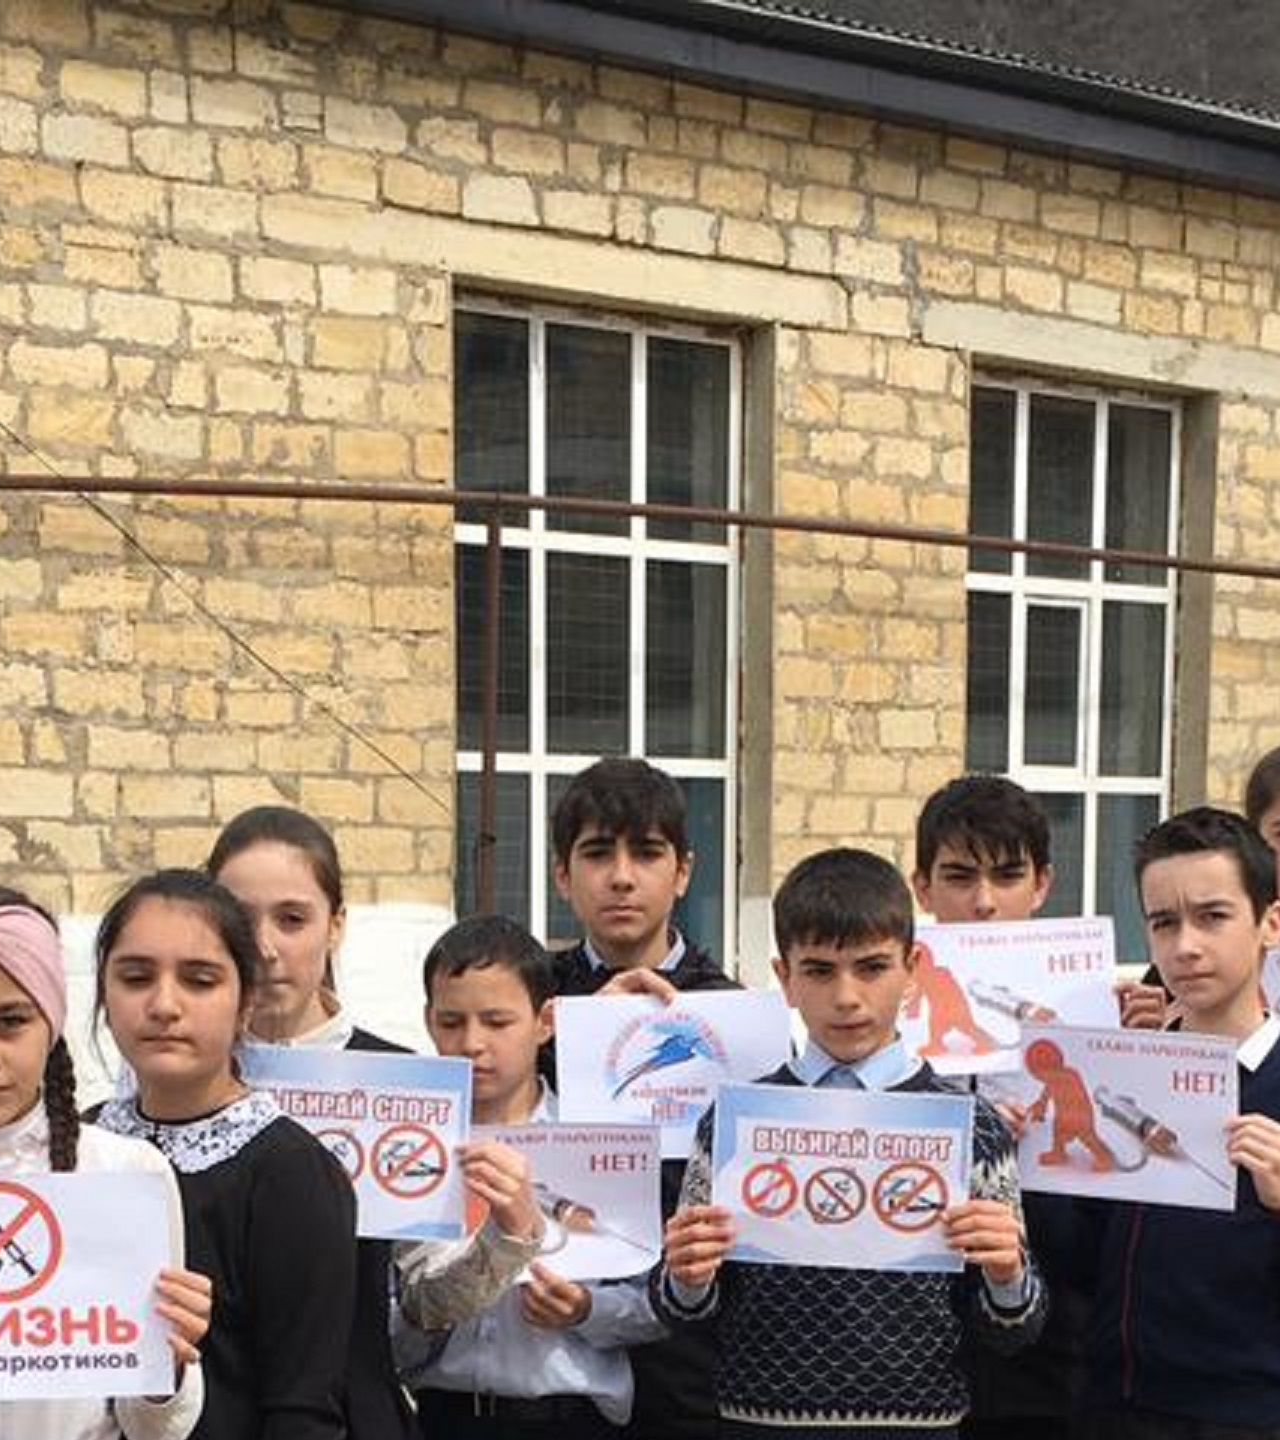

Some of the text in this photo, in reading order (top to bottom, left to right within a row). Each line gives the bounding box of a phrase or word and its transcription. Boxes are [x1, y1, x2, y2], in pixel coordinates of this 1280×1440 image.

[1048, 951, 1104, 973] НЕТ!
[1172, 1070, 1227, 1096] НЕТ!
[271, 1087, 453, 1125] ЫБИРАЙ СПОРТ
[753, 1127, 953, 1162] ВЫБИРАЙ СПОРТ
[590, 1153, 648, 1172] НЕТ!
